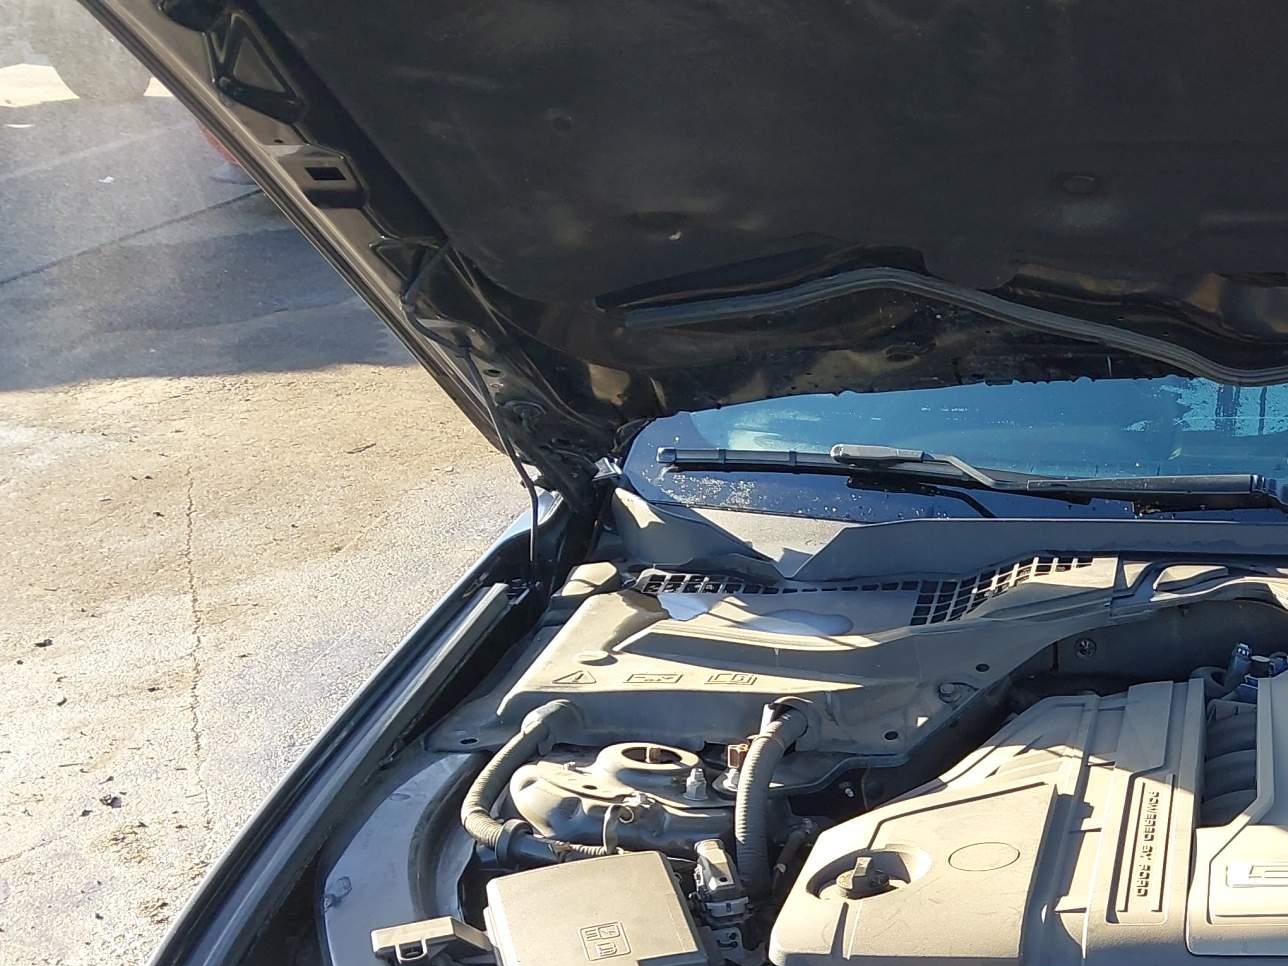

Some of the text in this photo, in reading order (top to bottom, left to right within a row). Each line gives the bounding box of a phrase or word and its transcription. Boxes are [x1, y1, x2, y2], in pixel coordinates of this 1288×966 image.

[1137, 791, 1159, 897] POWERED BY FORD
